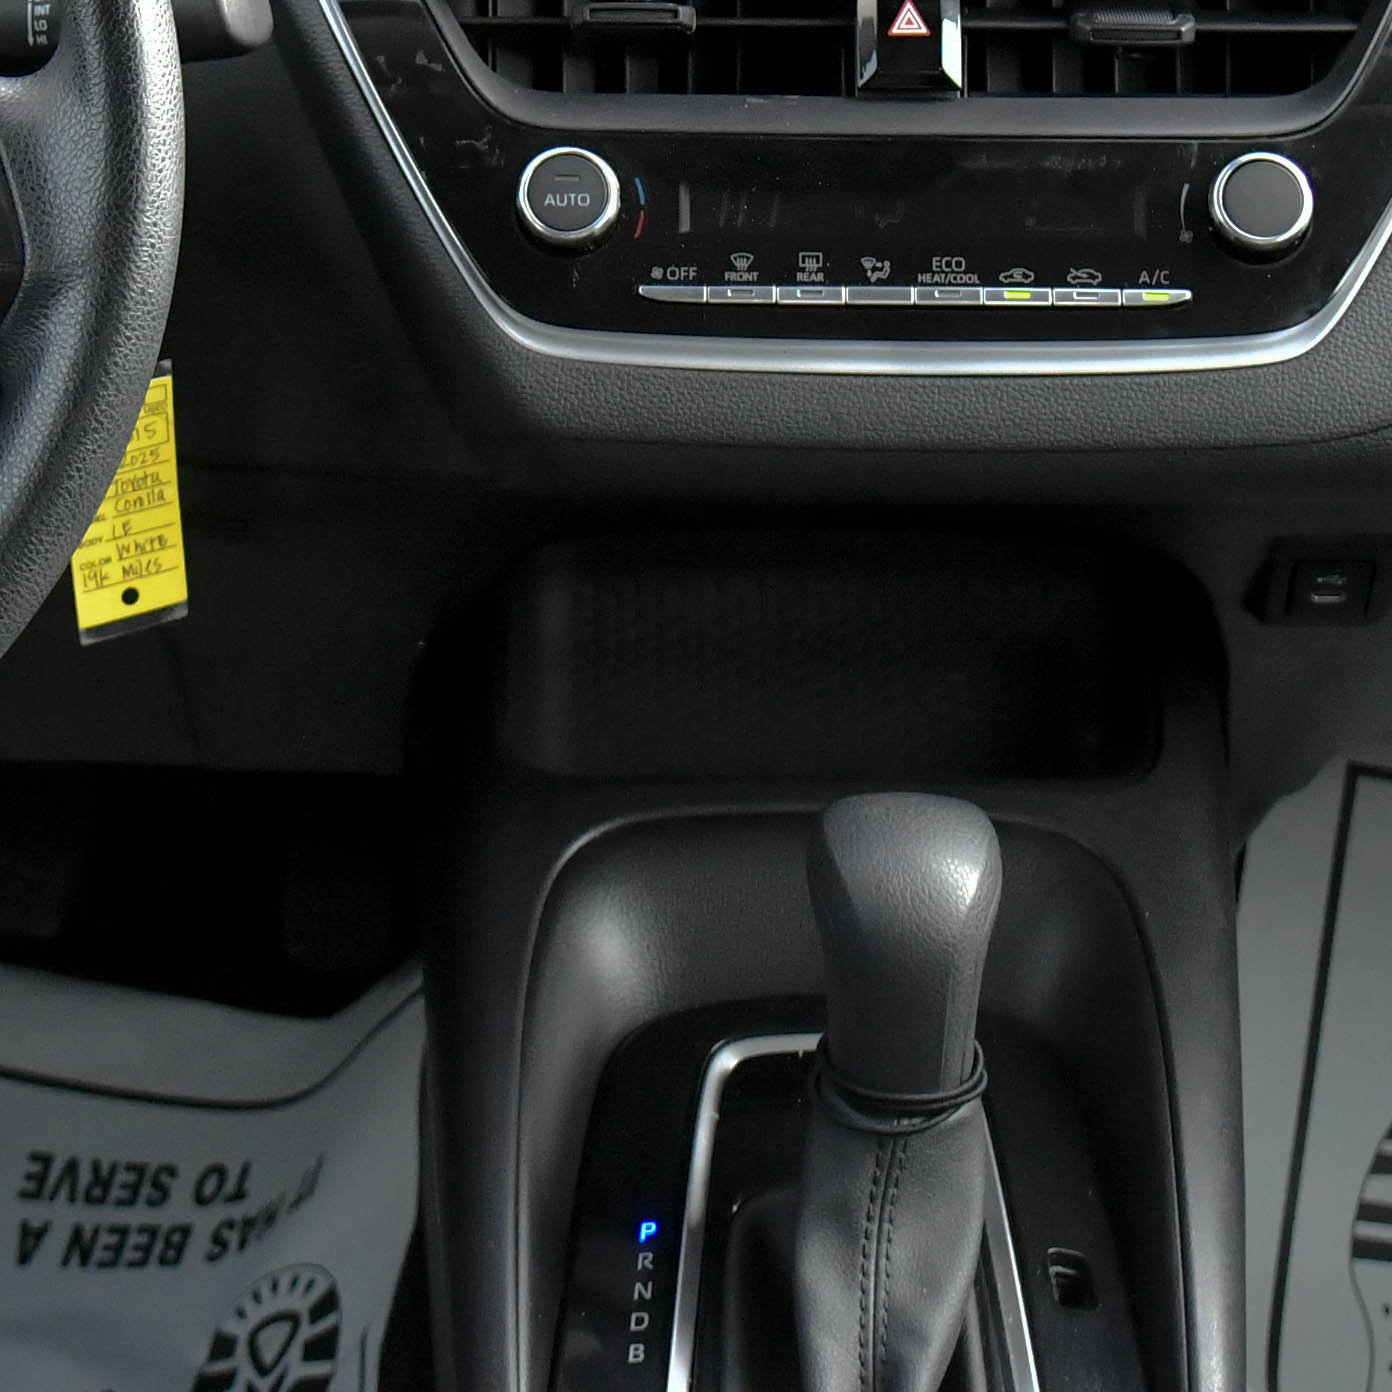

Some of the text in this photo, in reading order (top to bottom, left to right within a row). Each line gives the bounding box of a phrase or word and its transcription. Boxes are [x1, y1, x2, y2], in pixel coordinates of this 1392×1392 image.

[34, 19, 48, 32] LO
[544, 192, 590, 208] AUTO
[666, 265, 697, 281] OFF
[932, 257, 966, 272] ECO
[724, 271, 759, 283] FRONT
[796, 271, 825, 283] REAR
[917, 272, 980, 284] HEAT/COOL
[1138, 269, 1170, 286] A/C
[17, 1148, 179, 1209] SERVE
[190, 1159, 253, 1208] TO
[639, 1220, 658, 1244] P
[17, 1219, 50, 1265] A
[63, 1222, 192, 1268] BEEN
[637, 1252, 654, 1271] R
[633, 1281, 653, 1301] N
[630, 1311, 649, 1332] D
[628, 1343, 646, 1363] B
